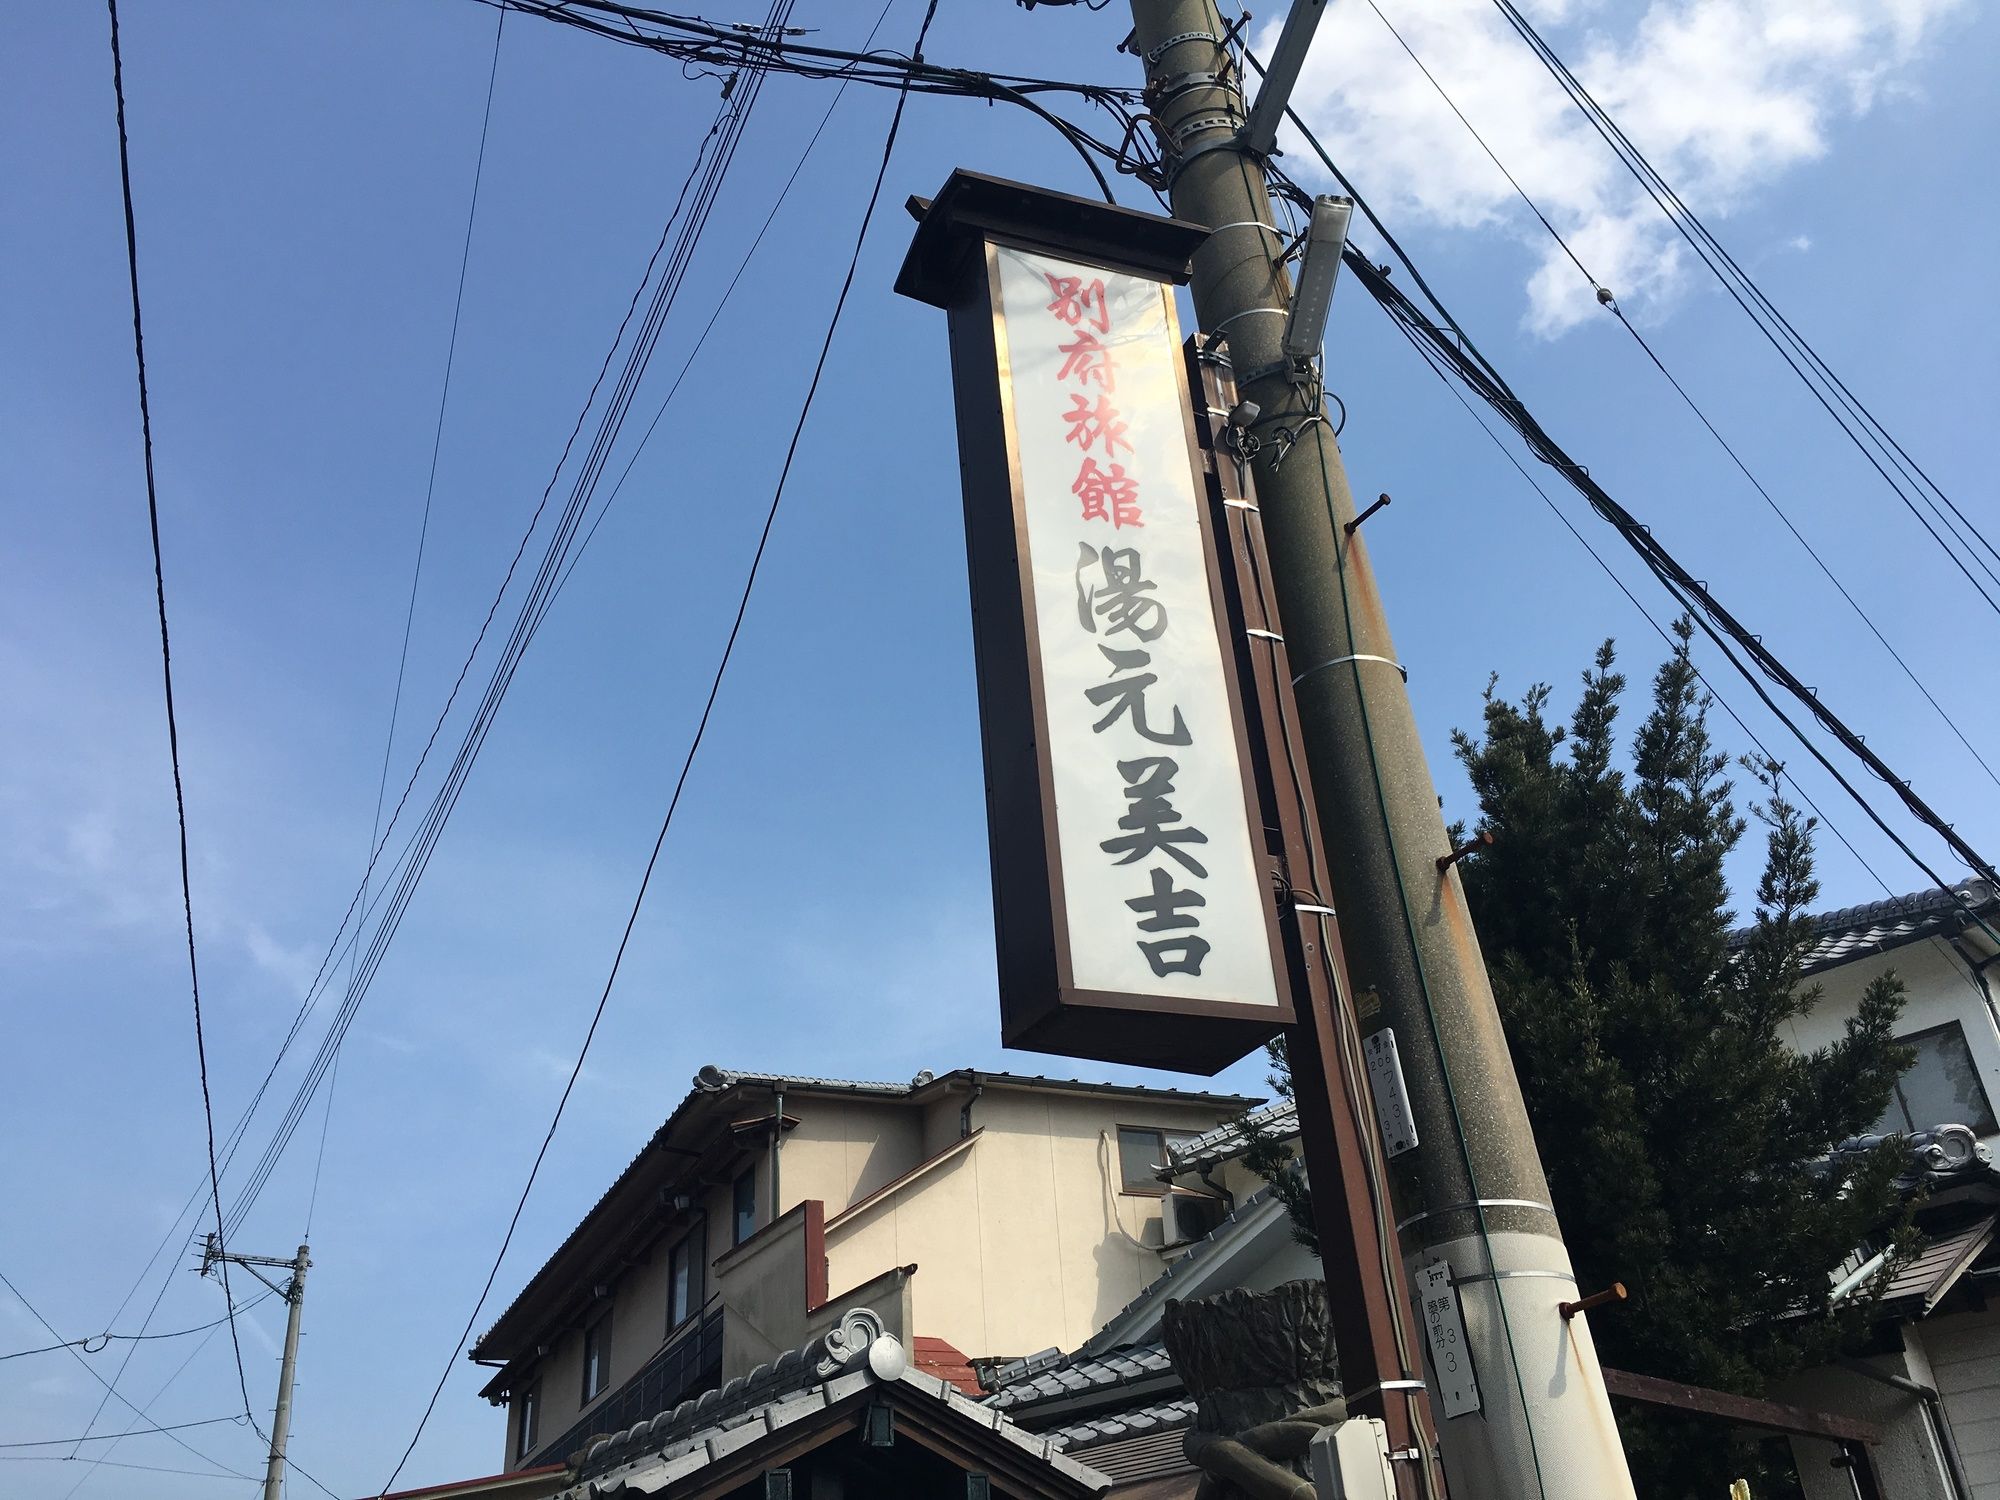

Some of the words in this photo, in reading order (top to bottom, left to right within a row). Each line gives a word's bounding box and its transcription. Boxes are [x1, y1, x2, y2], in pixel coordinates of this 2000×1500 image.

[1043, 271, 1145, 530] 別府旅館
[1075, 541, 1211, 977] 湯元美吉
[1370, 1054, 1391, 1072] 206
[1428, 1270, 1444, 1282] NTT
